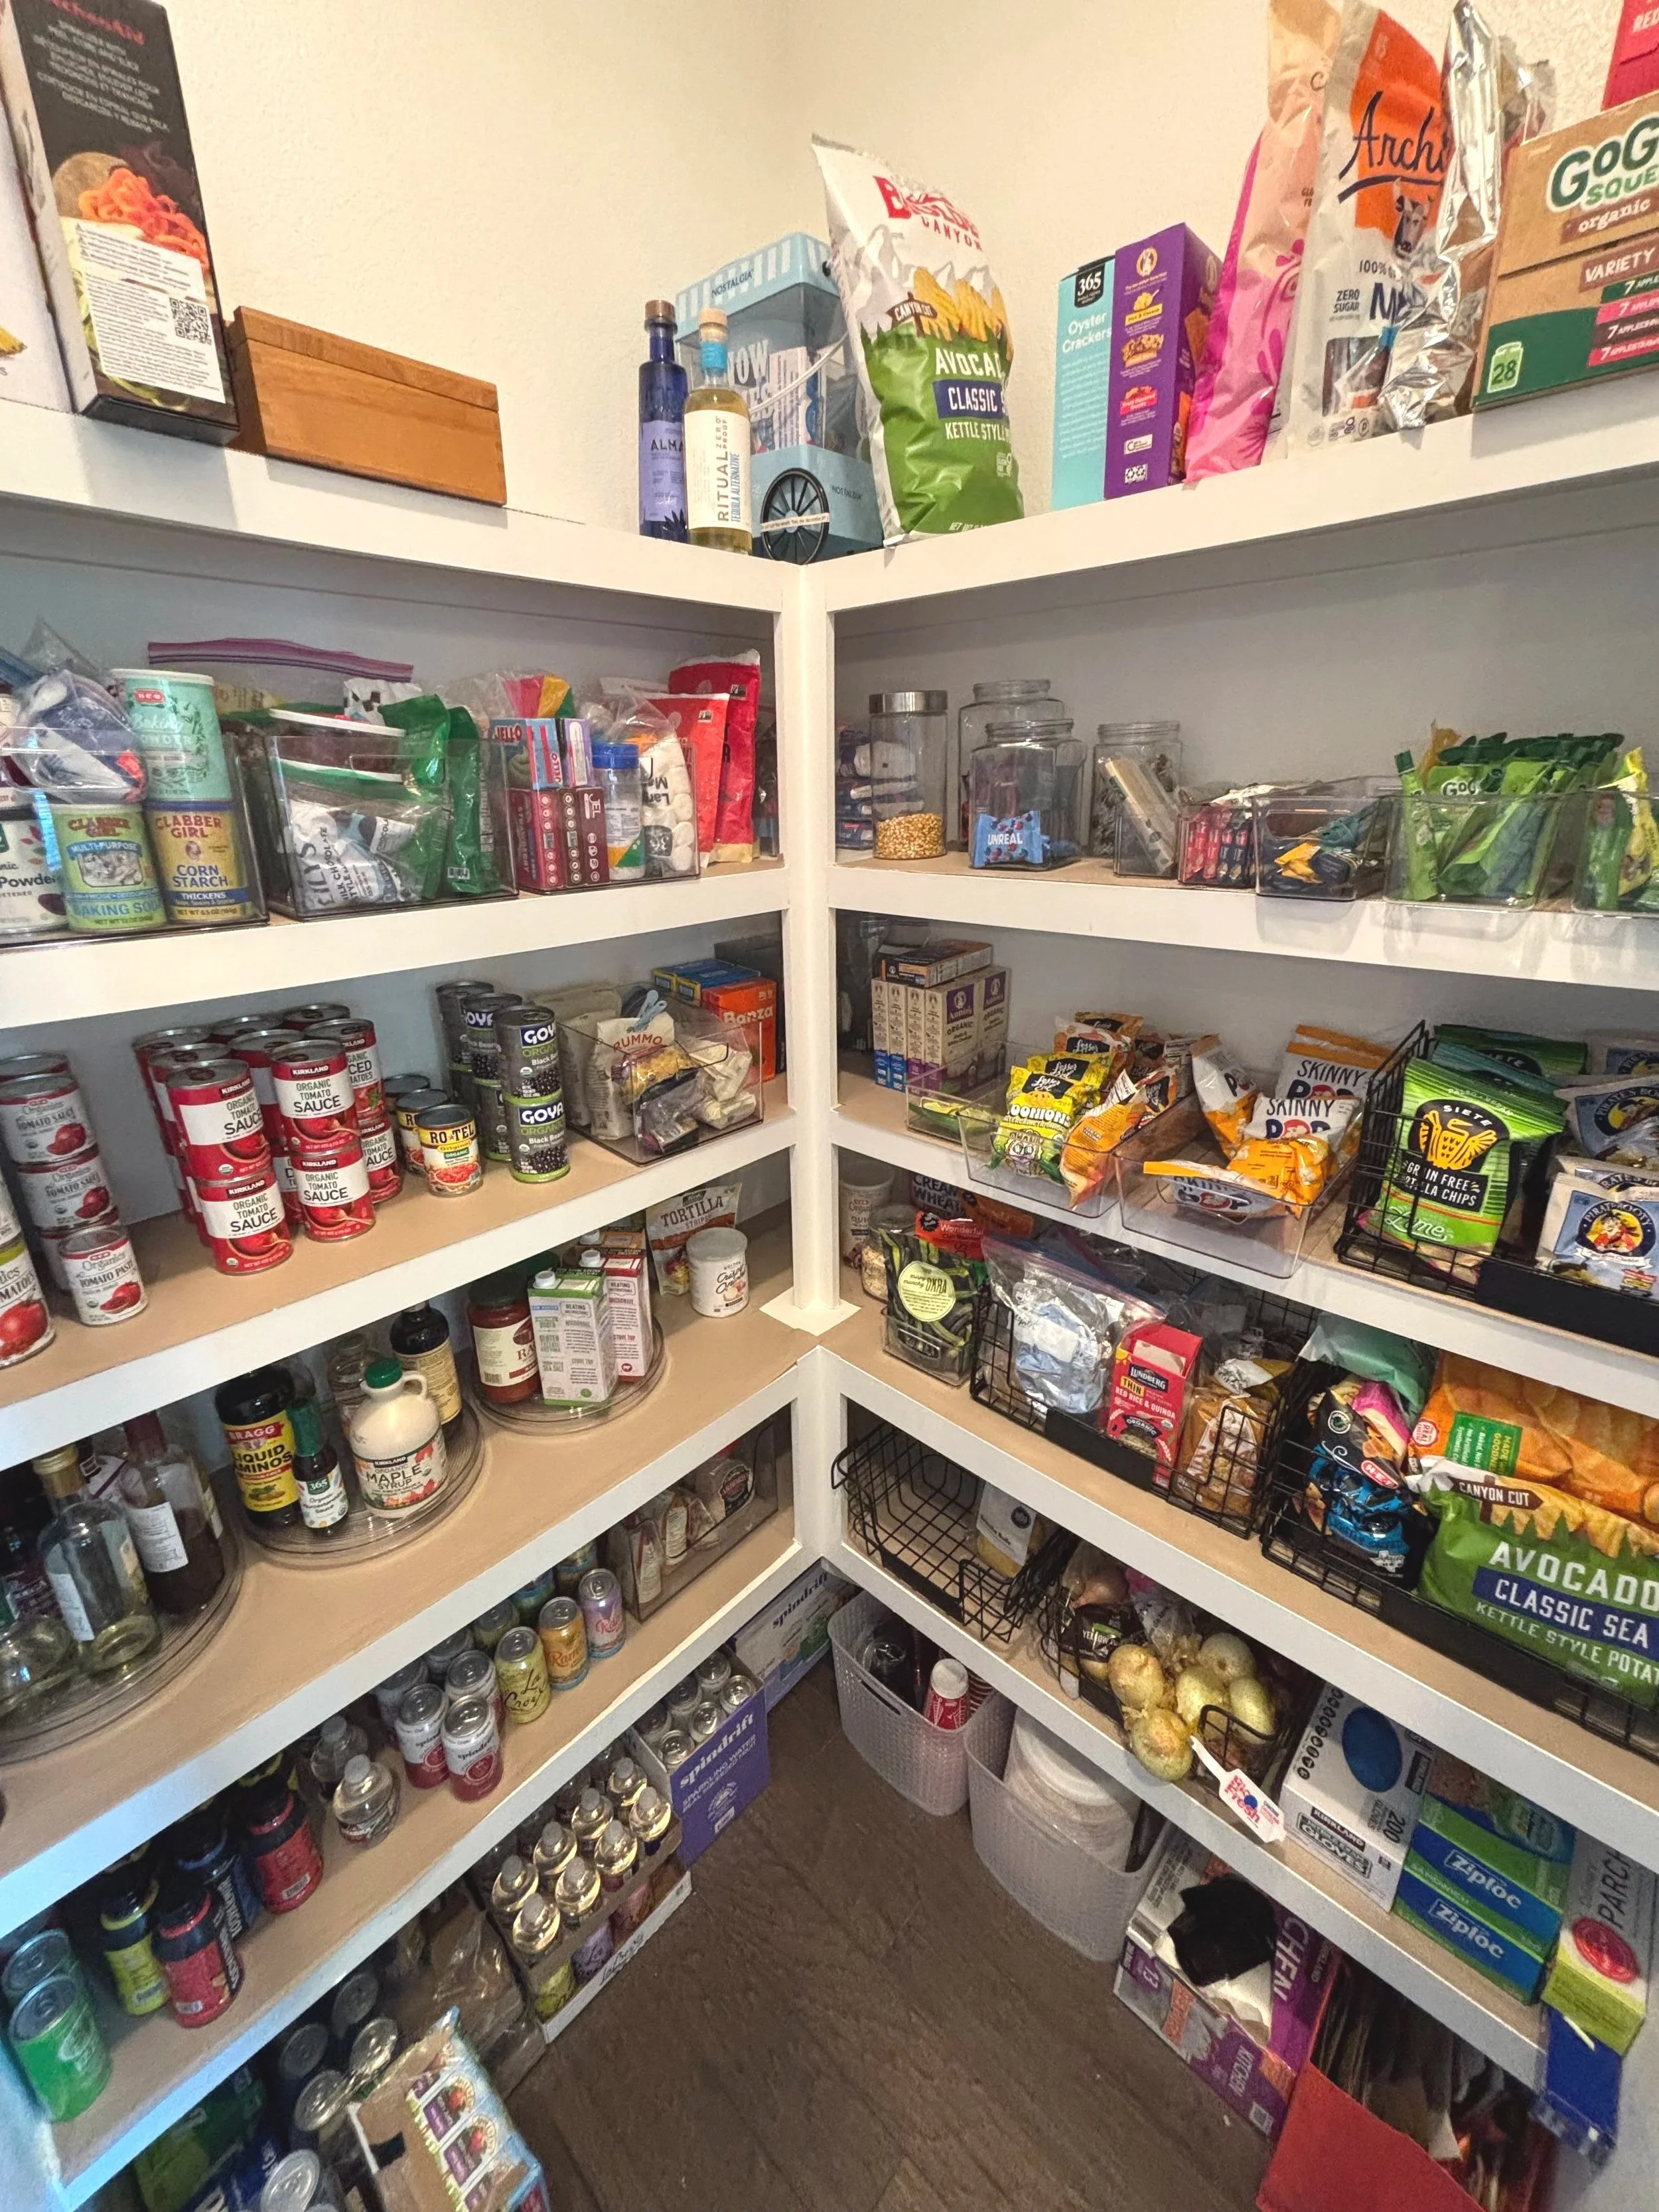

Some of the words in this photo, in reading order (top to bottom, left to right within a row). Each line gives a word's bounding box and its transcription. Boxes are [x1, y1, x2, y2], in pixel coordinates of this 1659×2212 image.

[1578, 198, 1650, 232] organic
[1585, 248, 1653, 283] VARIETY
[711, 270, 754, 297] NOSTALGIA
[1078, 271, 1102, 296] 365
[1624, 280, 1635, 295] 7
[1336, 289, 1360, 301] ZERO
[1334, 301, 1360, 314] SUGAR
[1619, 302, 1630, 317] 7
[1068, 312, 1106, 336] Oyster
[1608, 324, 1619, 339] 7
[1062, 327, 1112, 353] Crackers
[1601, 347, 1611, 360] 7
[1492, 359, 1518, 386] 28
[948, 387, 997, 412] CLASSIC
[945, 422, 978, 440] KETTLE
[731, 452, 741, 492] ALTERNATIVE
[717, 451, 729, 522] RITUAL
[731, 494, 741, 523] TEQUILA
[492, 723, 522, 744] JELL-O
[155, 815, 222, 830] CLABBER
[171, 827, 209, 839] GIRL
[987, 834, 1023, 846] UNREAL
[70, 841, 138, 852] MULTI-PURPOSE
[177, 864, 219, 877] CORN
[173, 875, 229, 888] STARCH
[181, 891, 227, 901] THICKENS
[724, 1005, 773, 1024] Banza
[613, 1033, 662, 1051] RUMMO
[293, 1065, 329, 1075] KIRKLAND
[532, 1056, 550, 1066] Black
[1031, 1075, 1061, 1088] Lesser
[1297, 1060, 1367, 1086] SKINNY
[222, 1078, 251, 1095] KIRKLAND
[296, 1078, 331, 1092] ORGANIC
[226, 1094, 255, 1112] ORGANIC
[299, 1088, 330, 1101] TOMATO
[231, 1103, 256, 1120] TOMATO
[293, 1095, 341, 1114] SAUCE
[522, 1102, 563, 1124] GOYA
[1267, 1098, 1335, 1117] SKINNY
[1443, 1104, 1493, 1127] SIETE
[224, 1114, 262, 1136] SAUCE
[1265, 1119, 1331, 1139] POP
[438, 1141, 471, 1151] Original
[529, 1136, 549, 1145] Black
[302, 1159, 336, 1168] KIRKLAND
[367, 1147, 393, 1166] AUCE
[445, 1150, 469, 1159] ORGANIC
[305, 1171, 338, 1183] ORGANIC
[1407, 1161, 1437, 1181] GRIN
[1440, 1173, 1469, 1191] FREE
[229, 1179, 265, 1195] KIRKLAND
[304, 1187, 348, 1202] SAUCE
[309, 1181, 338, 1191] TOMATO
[234, 1193, 268, 1211] ORGANIC
[1441, 1188, 1478, 1207] CHIPS
[230, 1208, 277, 1232] SAUCE
[237, 1203, 268, 1220] TOMATO
[661, 1196, 723, 1227] TORTILLA
[686, 1215, 712, 1228] STRIPS
[940, 1224, 984, 1235] Wonderful
[82, 1250, 127, 1271] Organics
[80, 1272, 115, 1289] TOMATO
[717, 1264, 745, 1283] Crispy
[910, 1274, 926, 1283] crispy
[902, 1279, 925, 1288] crunchy
[925, 1277, 948, 1294] OKRA
[1121, 1377, 1142, 1394] THIN
[1130, 1366, 1166, 1390] LUNDBERG
[1115, 1386, 1128, 1398] RED
[1129, 1392, 1144, 1405] RICE
[1144, 1400, 1150, 1409] &
[1151, 1403, 1176, 1419] QUINOA
[227, 1426, 276, 1441] BRAGG
[1126, 1418, 1157, 1436] ORGANIC
[1419, 1423, 1433, 1445] REAL
[1503, 1435, 1513, 1455] MADE
[374, 1455, 407, 1467] KIRKLAND
[375, 1463, 408, 1475] ORGANIC
[366, 1463, 422, 1485] MAPLE
[309, 1479, 328, 1491] 365
[378, 1477, 412, 1491] SYRUP
[1459, 1483, 1503, 1503] CANYON
[1508, 1491, 1529, 1507] CUT
[1488, 1541, 1659, 1611] AVOCADO
[772, 1572, 828, 1629] spindrift
[1494, 1579, 1593, 1631] CLASSIC
[1603, 1614, 1648, 1649] SEA
[1477, 1601, 1540, 1638] KETTLE
[1545, 1629, 1602, 1664] STYLE
[680, 1712, 755, 1790] spindrift
[682, 1759, 728, 1807] SPARKLING
[727, 1733, 758, 1764] WATER
[1313, 1807, 1365, 1850] KIRKLAND
[1382, 1809, 1406, 1844] 200
[1301, 1823, 1368, 1875] GLOVES
[1451, 1854, 1522, 1910] Ziploc
[1435, 1903, 1505, 1959] Ziploc
[1228, 2044, 1254, 2097] KITCHEN
